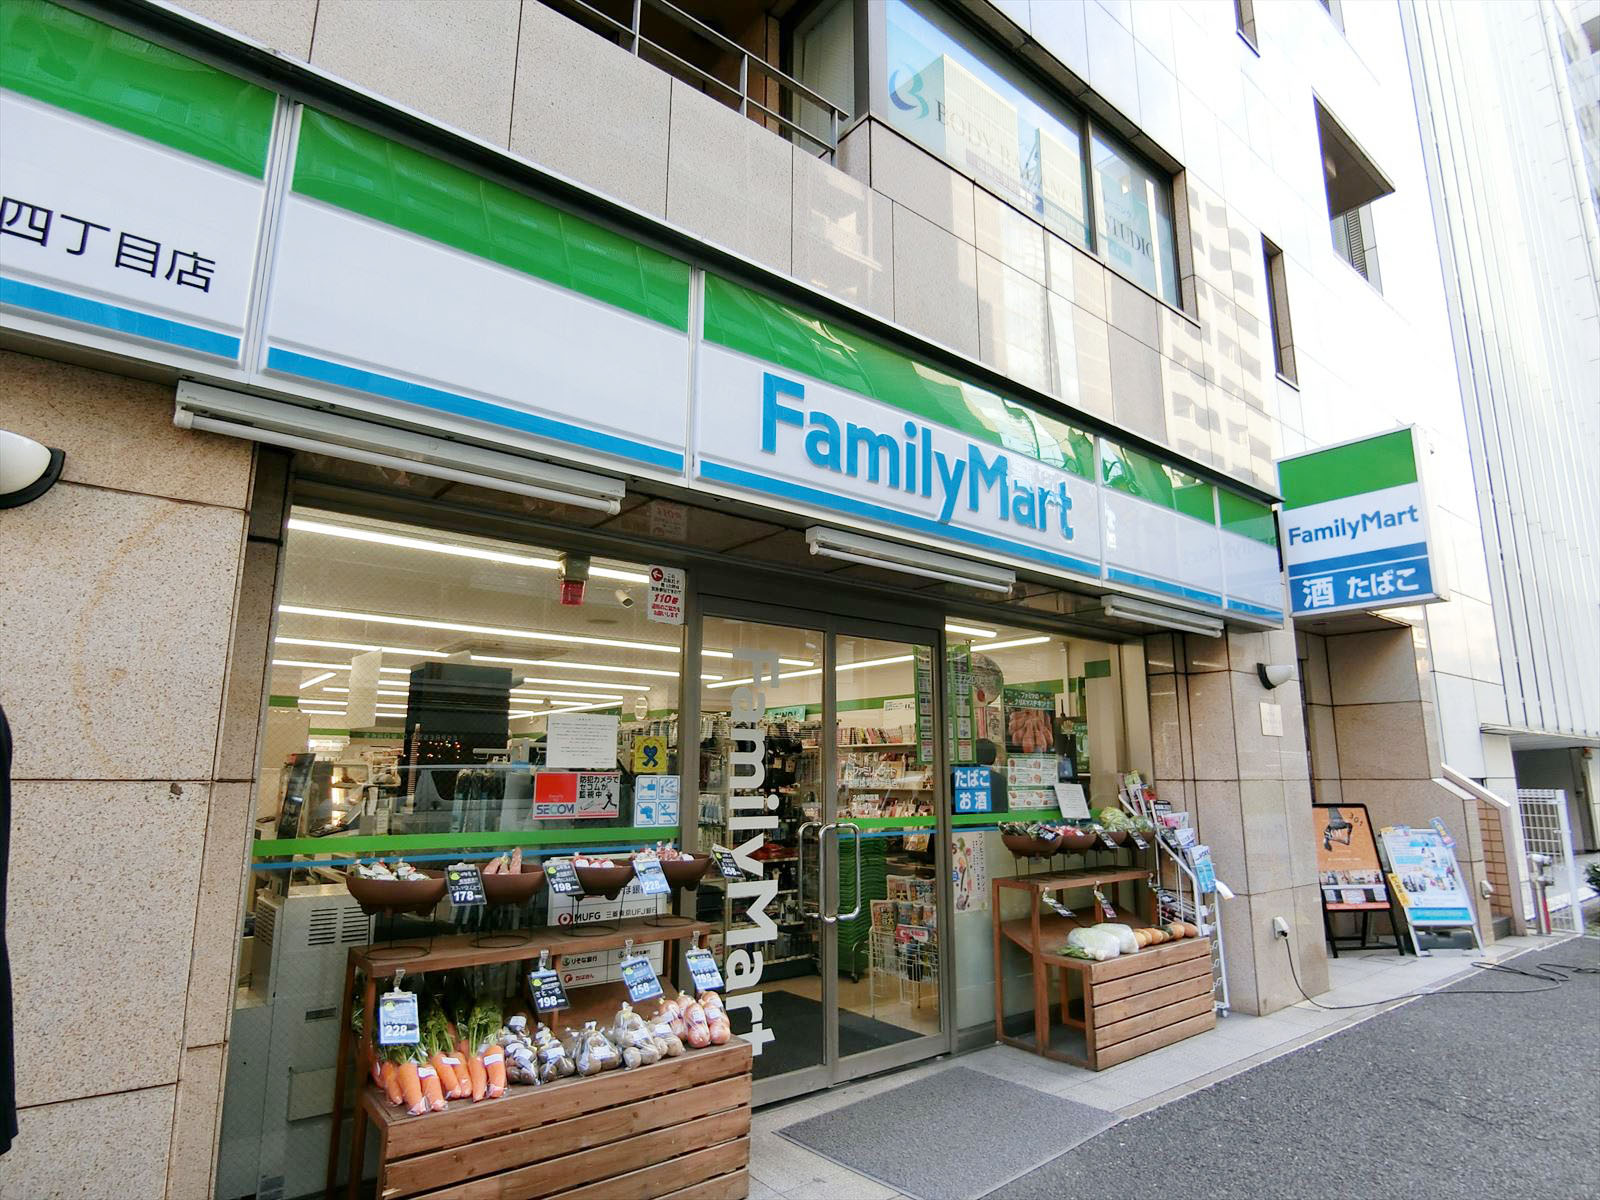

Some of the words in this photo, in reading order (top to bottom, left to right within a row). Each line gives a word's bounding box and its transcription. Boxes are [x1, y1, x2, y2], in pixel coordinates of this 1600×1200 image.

[0, 196, 216, 293] 四丁目店
[761, 371, 1075, 541] FamilyMart
[1288, 504, 1419, 546] FamilyMart
[1302, 576, 1335, 609] 酒
[1346, 567, 1420, 599] たばこ
[579, 775, 619, 785] 防犯カメラで
[955, 768, 990, 789] たばこ
[579, 783, 608, 792] セコムが
[579, 790, 603, 800] 監視中
[959, 790, 988, 811] お酒
[536, 803, 575, 815] SECOM
[726, 647, 780, 1056] FamilyMart
[553, 882, 572, 893] 198
[644, 880, 661, 891] 228
[453, 890, 475, 902] 178
[574, 911, 601, 922] MUFG
[631, 982, 650, 996] 158
[537, 995, 558, 1009] 198
[385, 1024, 408, 1037] 228
